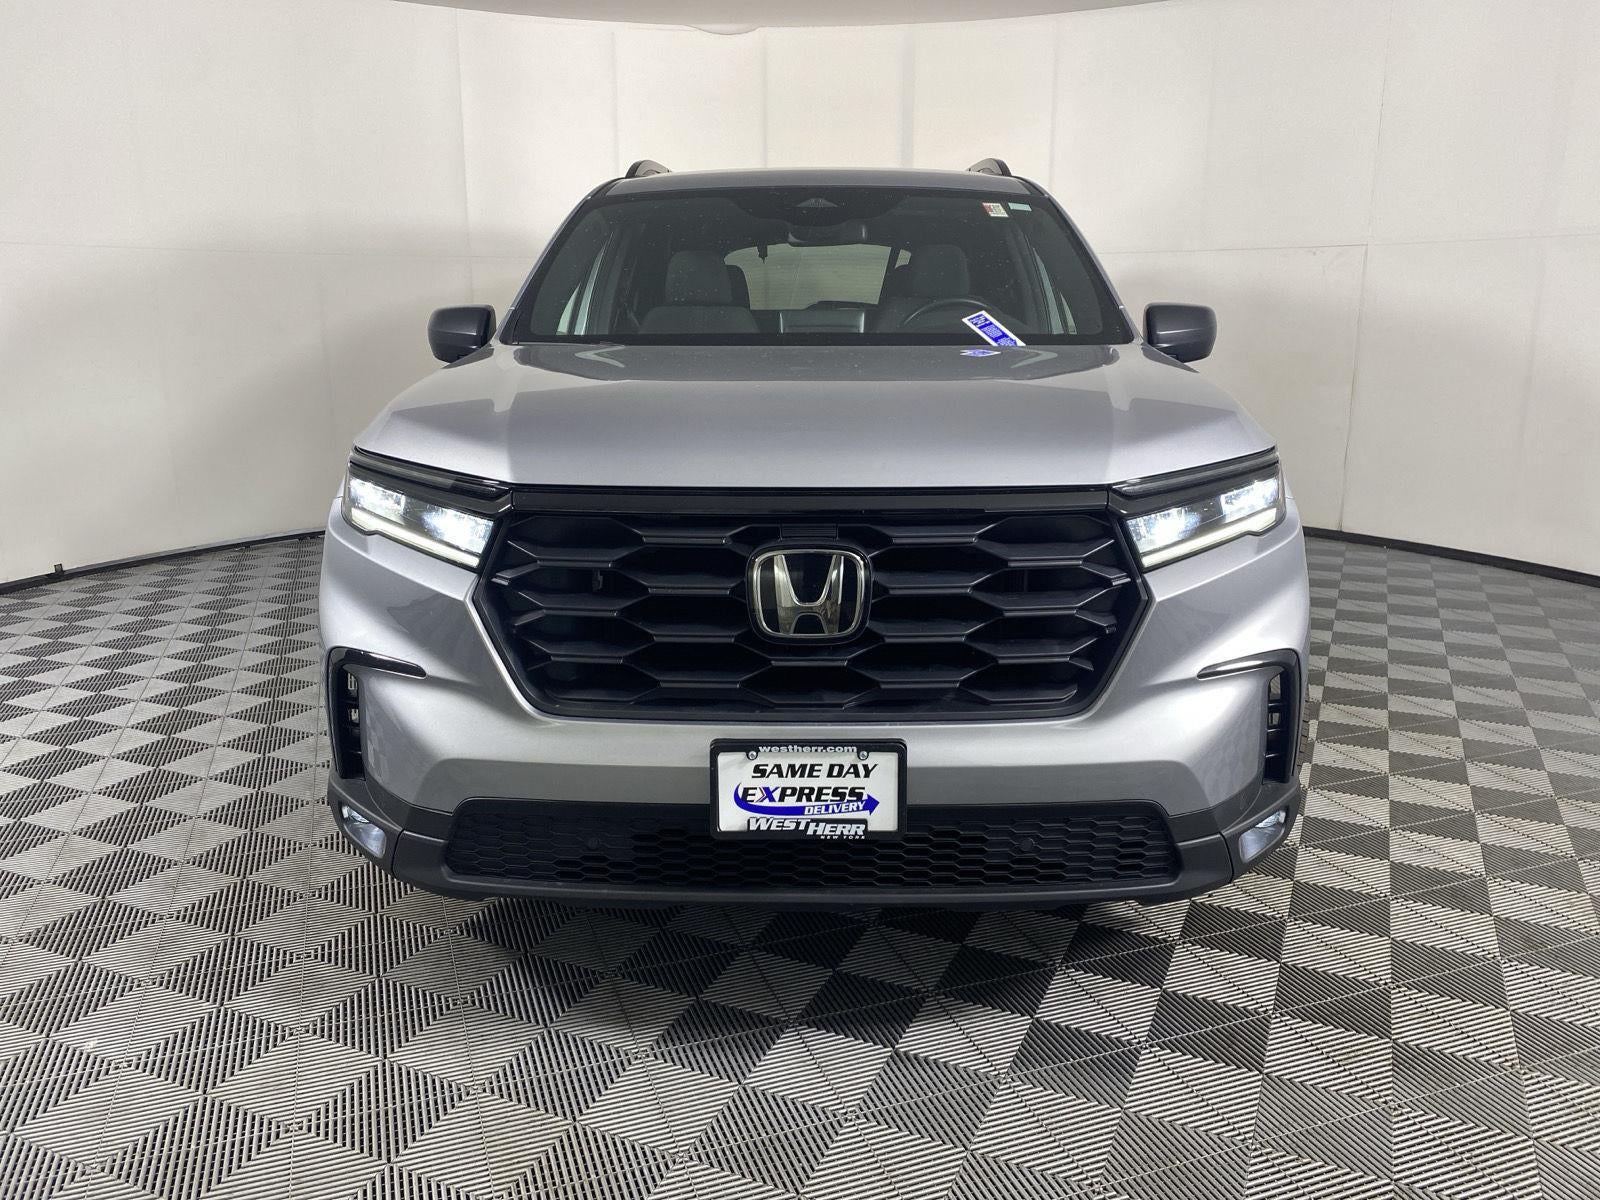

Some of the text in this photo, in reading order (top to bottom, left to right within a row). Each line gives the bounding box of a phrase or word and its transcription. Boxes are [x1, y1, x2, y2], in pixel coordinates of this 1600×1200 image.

[758, 745, 858, 753] westherr.com
[751, 764, 879, 778] SAME DAY
[741, 787, 866, 802] EXPRESS
[804, 802, 866, 815] DELIVERY
